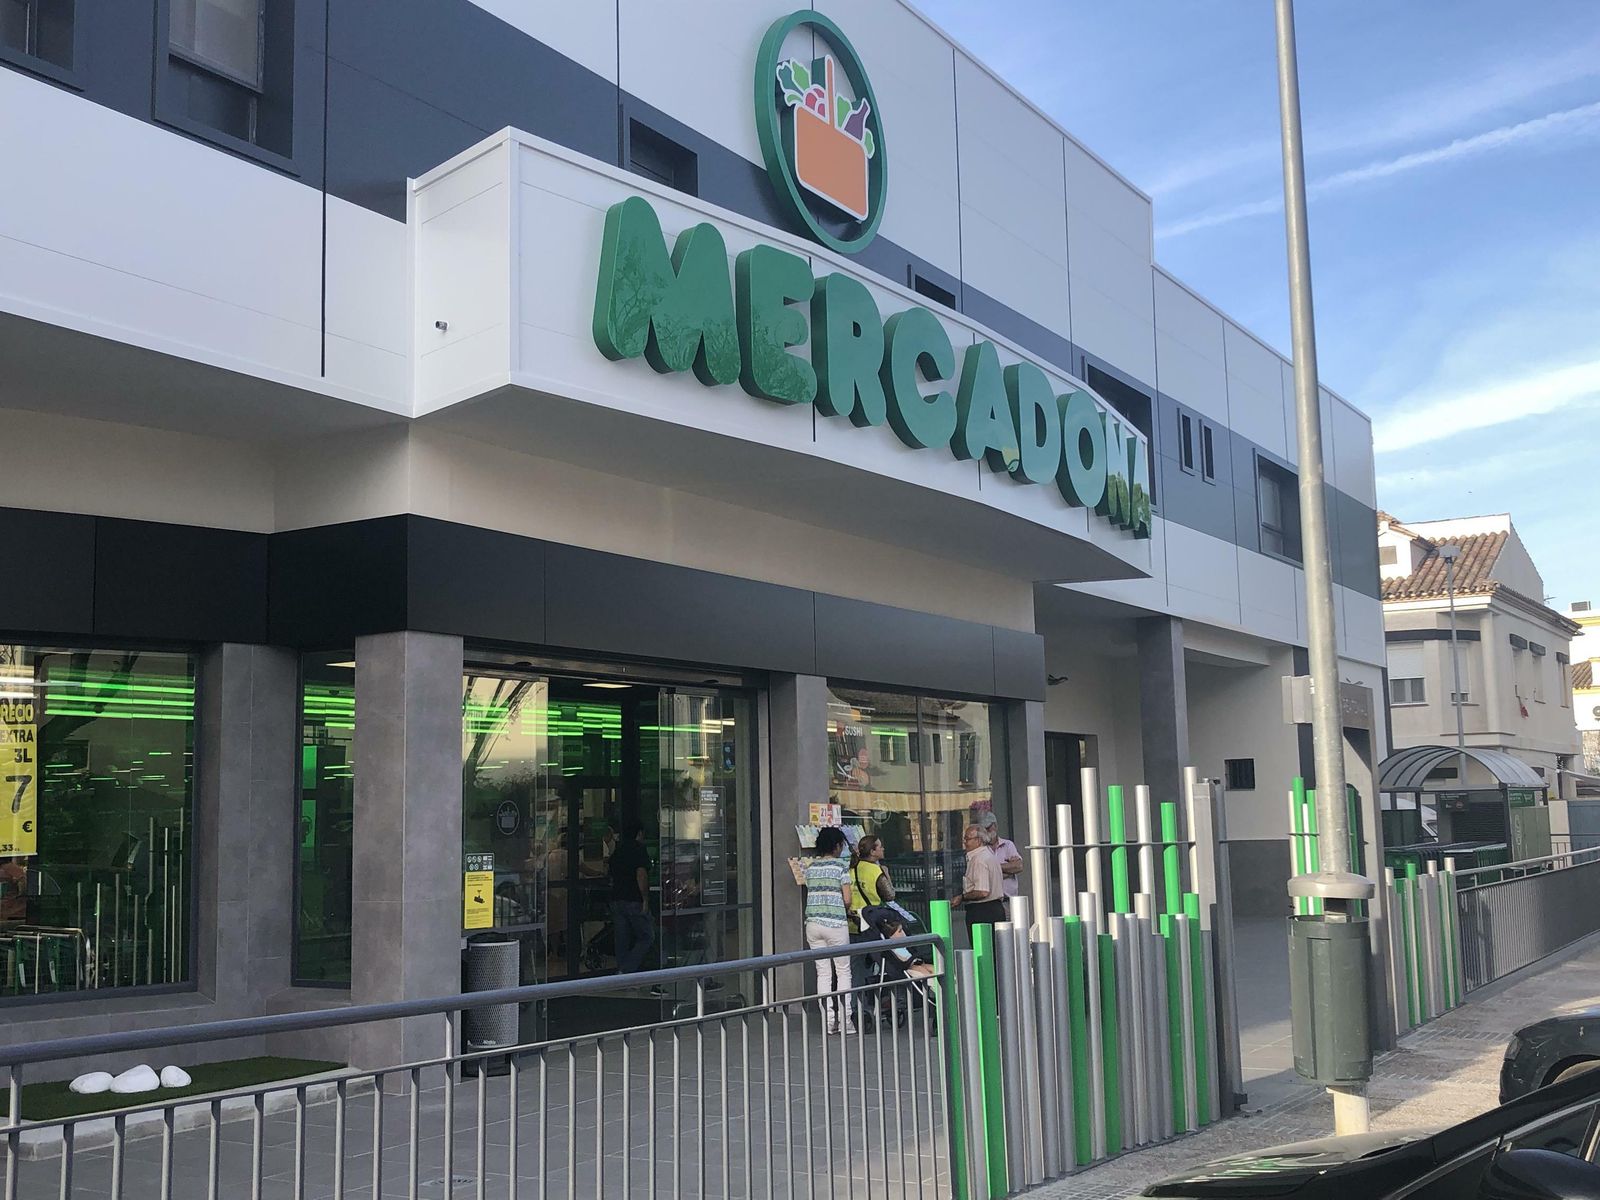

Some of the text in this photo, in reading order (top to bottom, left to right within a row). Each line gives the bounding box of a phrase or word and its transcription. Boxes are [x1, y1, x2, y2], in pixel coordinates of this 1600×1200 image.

[592, 196, 1151, 540] MERCADONA
[844, 725, 863, 737] SUSHI
[14, 748, 33, 764] 3L
